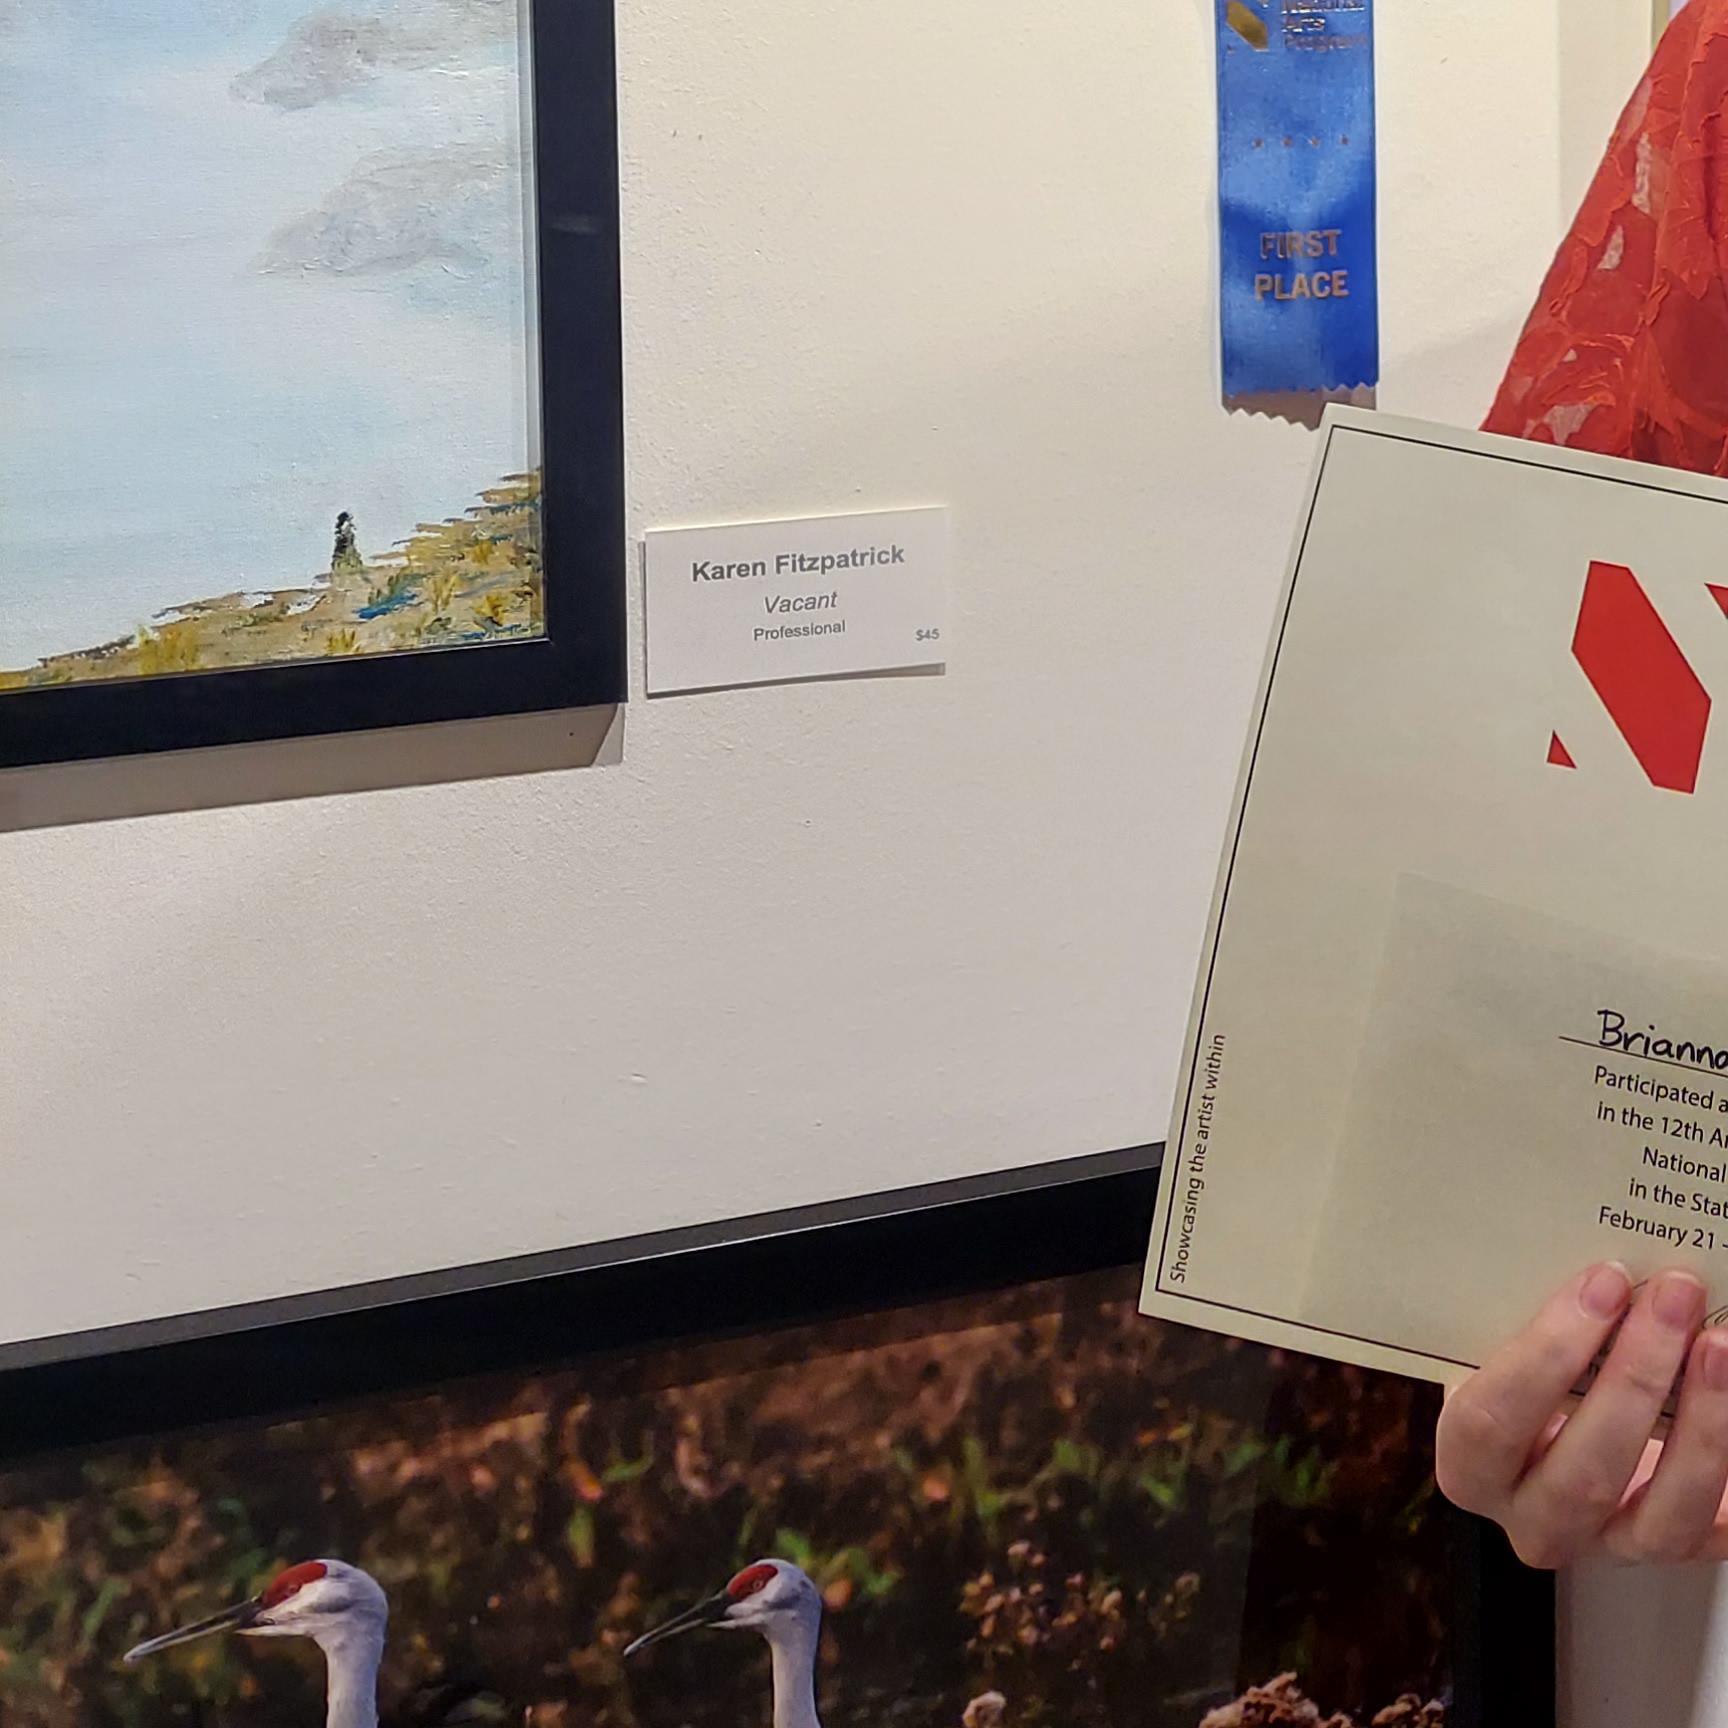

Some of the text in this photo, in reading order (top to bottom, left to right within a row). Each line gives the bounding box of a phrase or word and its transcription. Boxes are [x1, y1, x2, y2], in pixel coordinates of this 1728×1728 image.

[1260, 229, 1342, 259] FIRST
[1254, 270, 1350, 301] PLACE
[692, 545, 905, 582] Karen Fitzpatrick
[764, 591, 838, 614] Vacant
[753, 620, 846, 641] Professional
[915, 628, 940, 642] $45
[1594, 1066, 1713, 1110] Participated
[1597, 1102, 1616, 1122] in
[1621, 1107, 1653, 1131] the
[1661, 1116, 1704, 1143] 12th
[1170, 1034, 1226, 1283] Showcasing the artist within
[1643, 1146, 1727, 1184] National
[1629, 1178, 1647, 1199] in
[1652, 1184, 1686, 1208] the
[1598, 1206, 1689, 1247] February
[1692, 1229, 1714, 1250] 21
